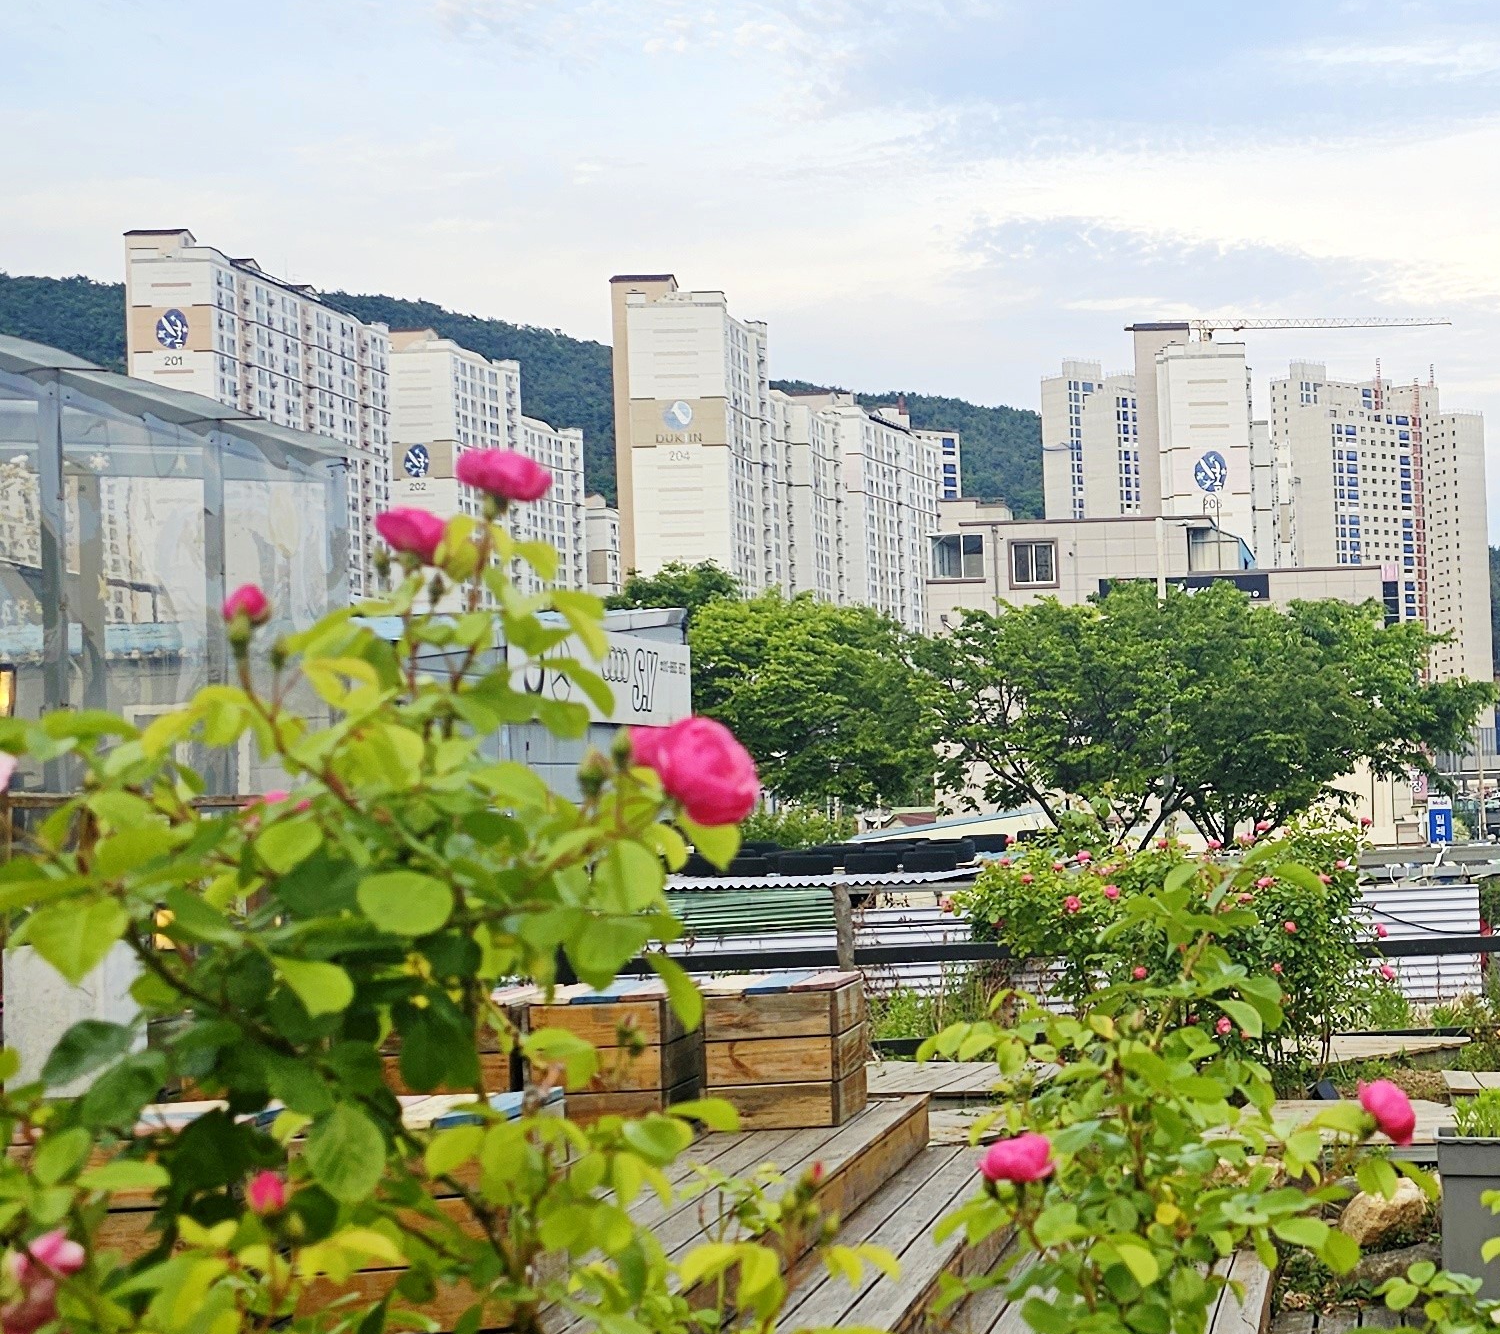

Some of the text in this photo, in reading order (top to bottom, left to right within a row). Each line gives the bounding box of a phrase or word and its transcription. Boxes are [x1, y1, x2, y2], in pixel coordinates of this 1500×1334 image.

[164, 356, 183, 366] 201
[669, 450, 690, 461] 204
[409, 482, 426, 491] 202
